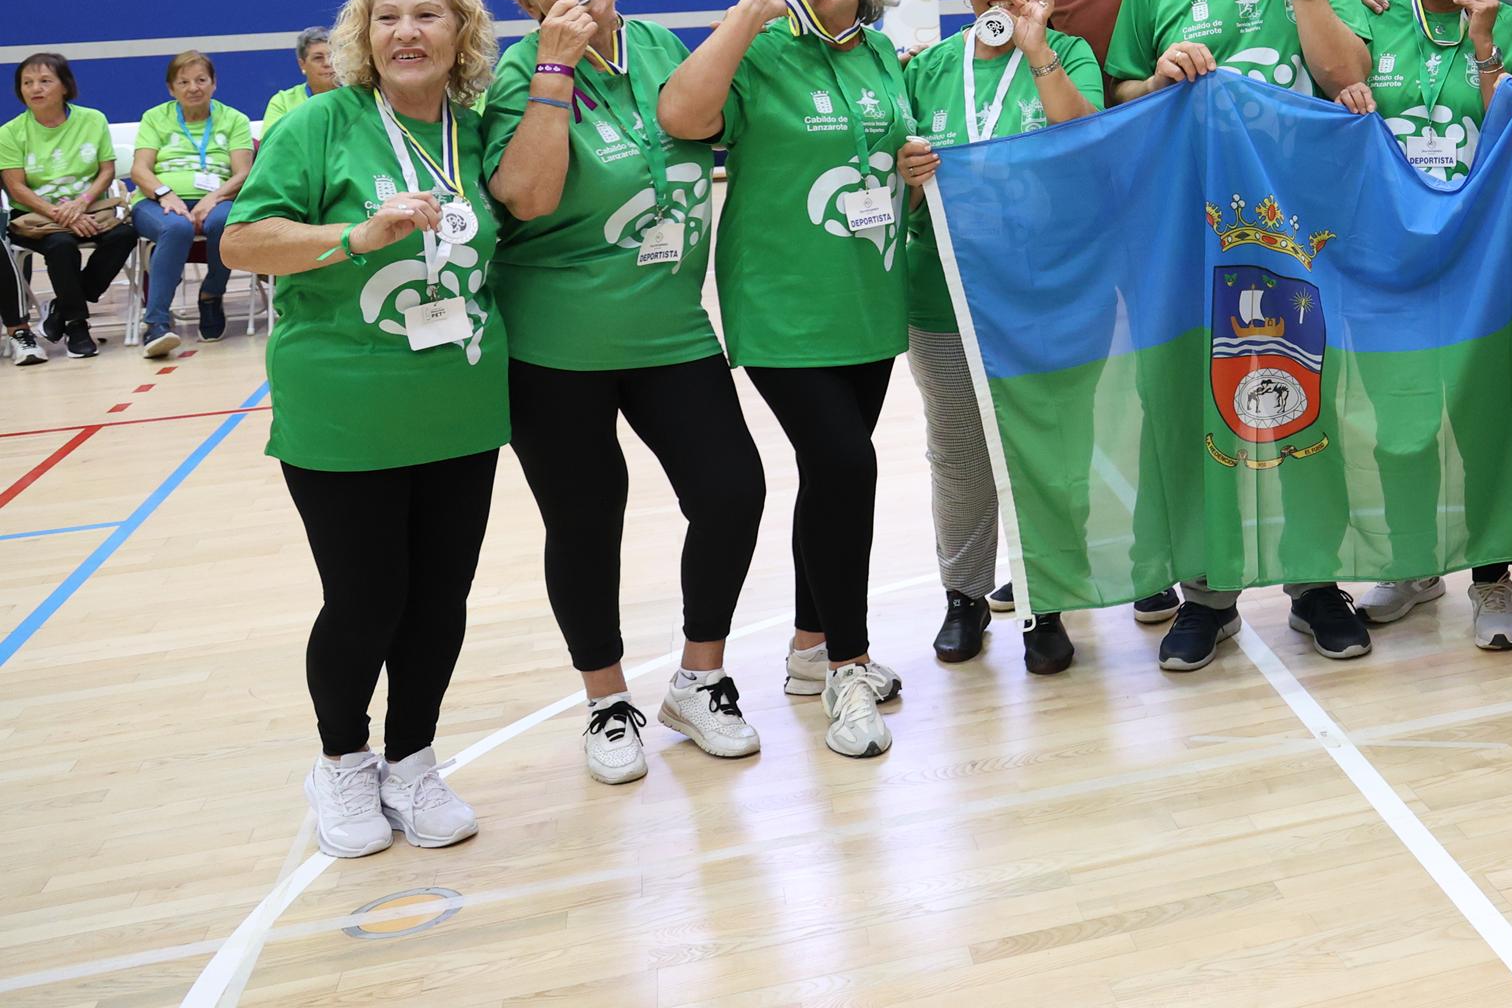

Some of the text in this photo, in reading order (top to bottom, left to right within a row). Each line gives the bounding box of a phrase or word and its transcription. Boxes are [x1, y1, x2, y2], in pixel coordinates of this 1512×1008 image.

[1409, 156, 1454, 165] DEPORTISTA
[850, 213, 892, 228] DEPORTISTA
[640, 250, 679, 263] DEPORTISTA
